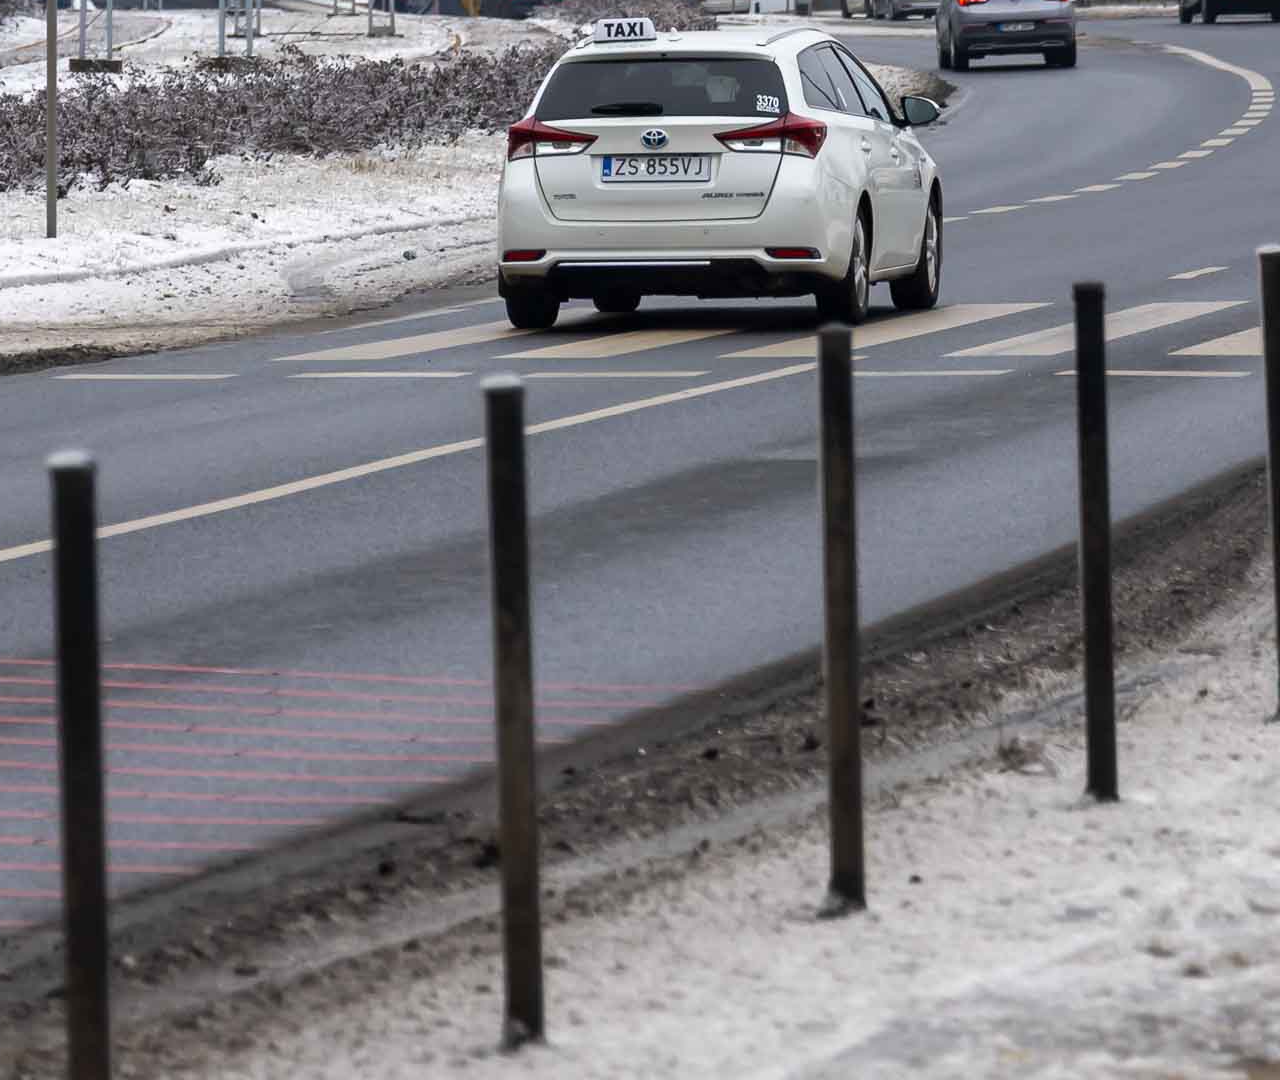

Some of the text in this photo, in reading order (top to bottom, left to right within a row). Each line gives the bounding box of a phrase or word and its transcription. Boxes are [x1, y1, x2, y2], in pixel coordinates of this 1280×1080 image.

[603, 21, 644, 38] TAXI
[756, 94, 780, 109] 3370
[615, 157, 703, 176] ZS 855VJ
